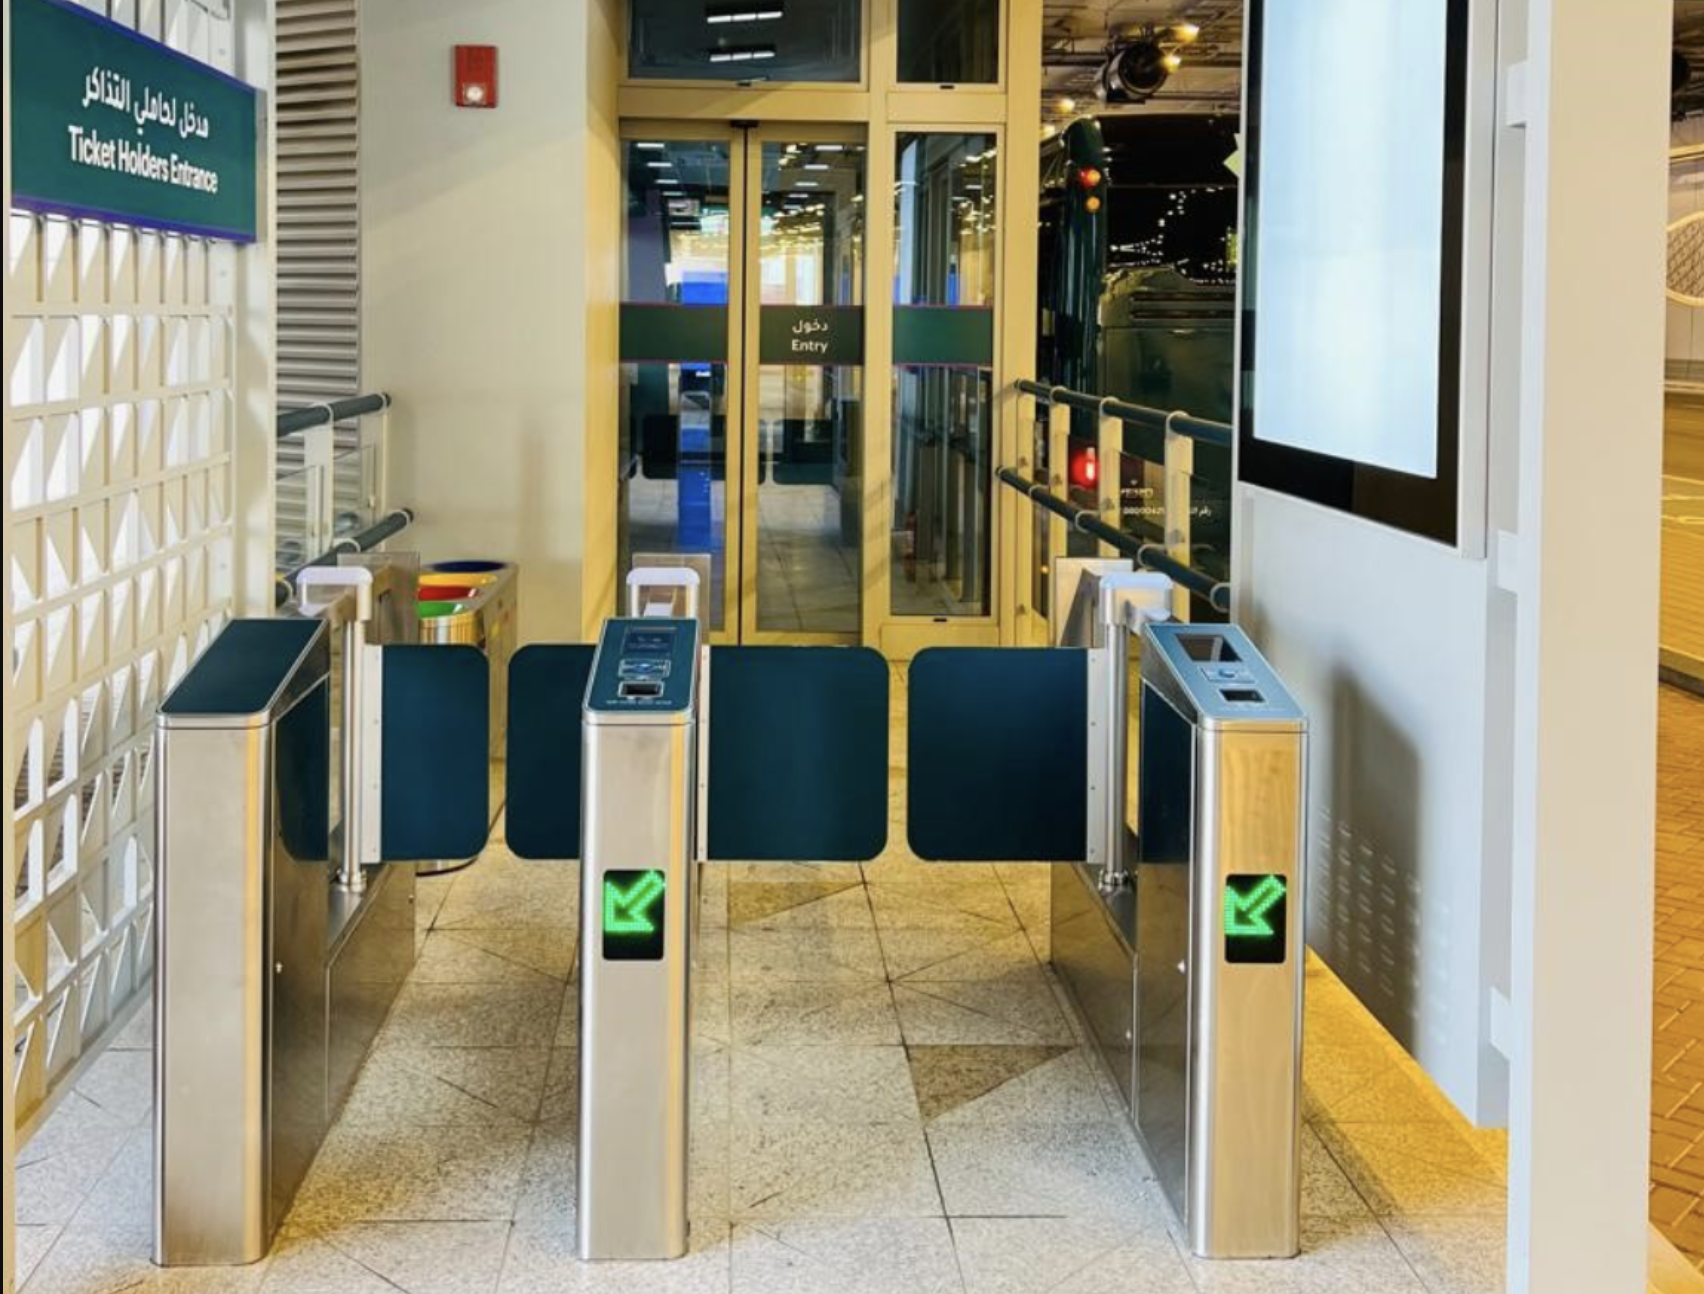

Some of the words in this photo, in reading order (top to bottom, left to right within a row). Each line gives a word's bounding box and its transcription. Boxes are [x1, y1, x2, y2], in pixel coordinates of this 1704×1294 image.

[82, 66, 131, 113] التذاكر
[134, 86, 176, 136] لحاملي
[179, 101, 208, 139] مدخل
[68, 124, 116, 170] Ticket
[118, 138, 169, 182] Holders
[170, 153, 219, 194] Entrance
[791, 318, 829, 336] دخول
[791, 339, 829, 355] Entry
